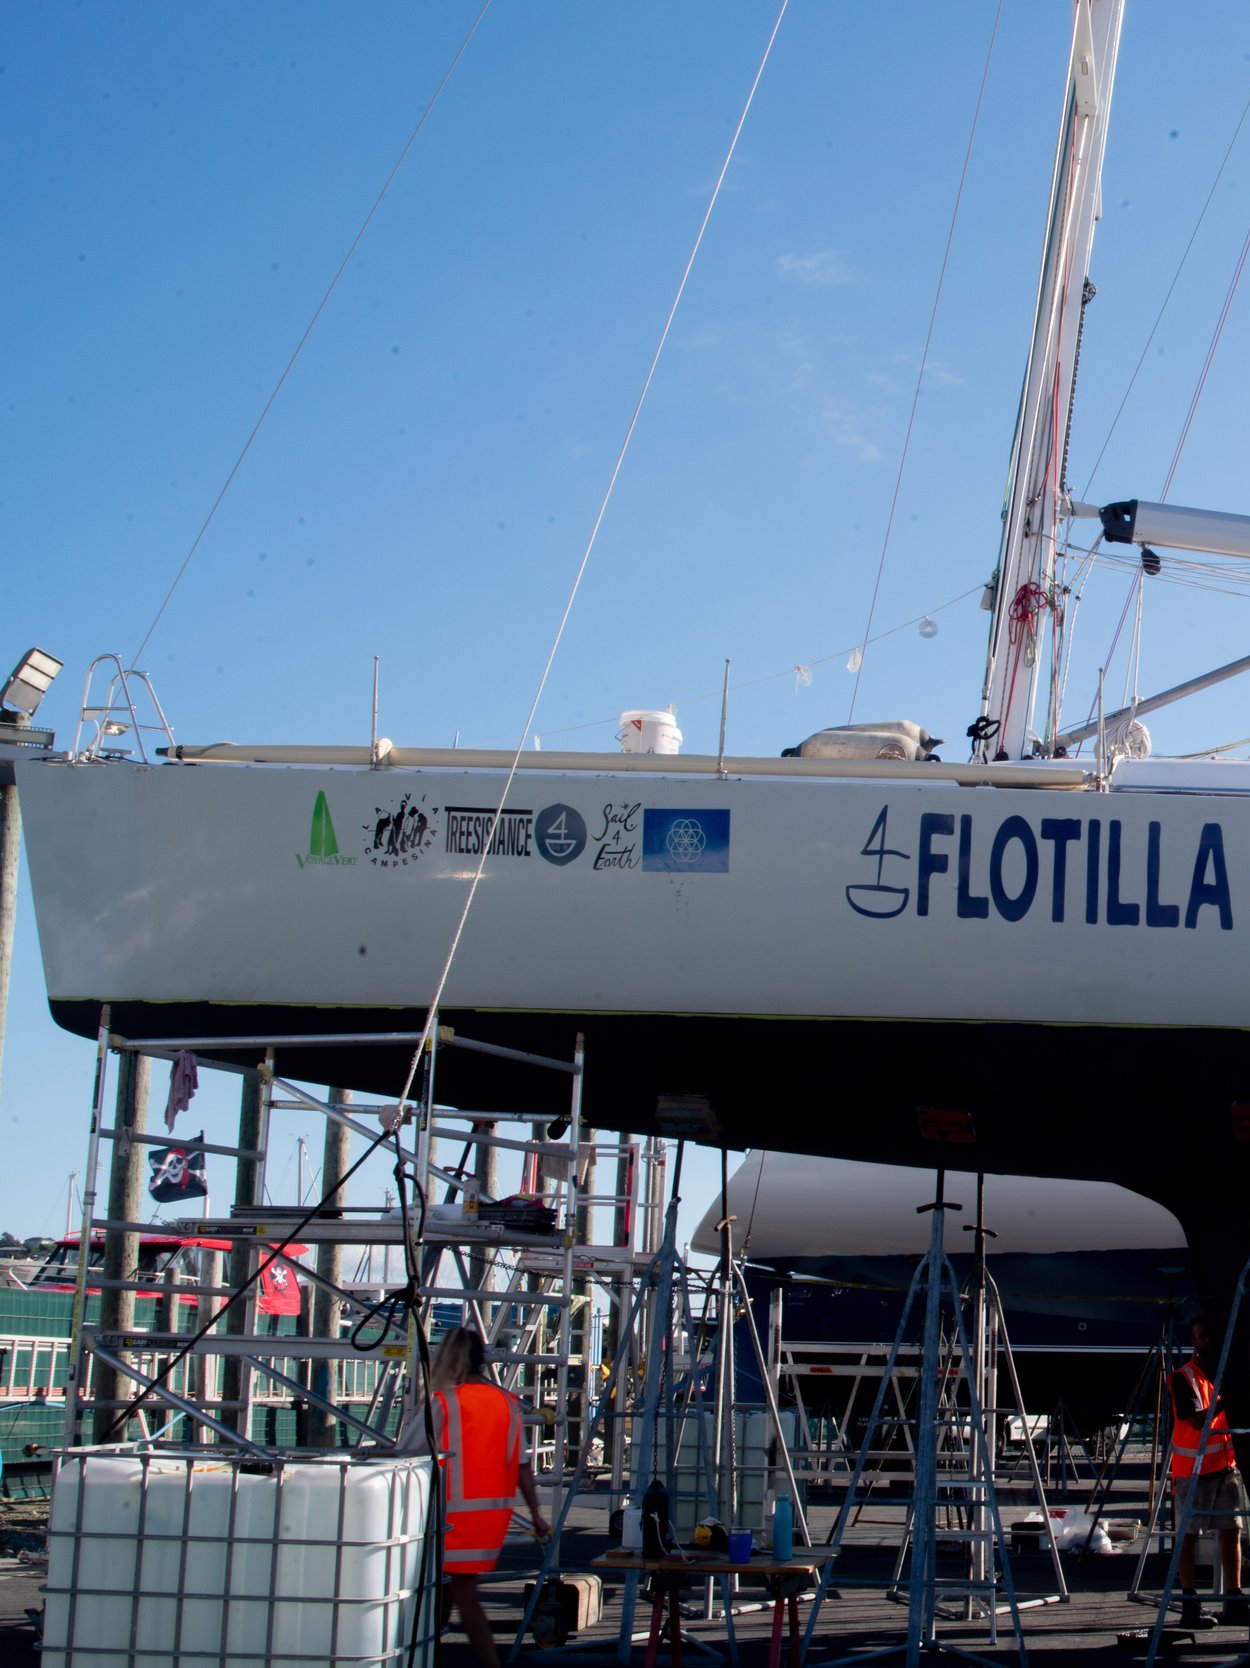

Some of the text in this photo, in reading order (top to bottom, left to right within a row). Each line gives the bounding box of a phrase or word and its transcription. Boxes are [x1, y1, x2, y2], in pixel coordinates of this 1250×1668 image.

[364, 828, 437, 868] CAMPESINA
[445, 806, 533, 856] TREESISTANCE
[612, 830, 622, 845] 4
[593, 843, 641, 870] Earth
[916, 812, 1233, 931] FLOTILLA
